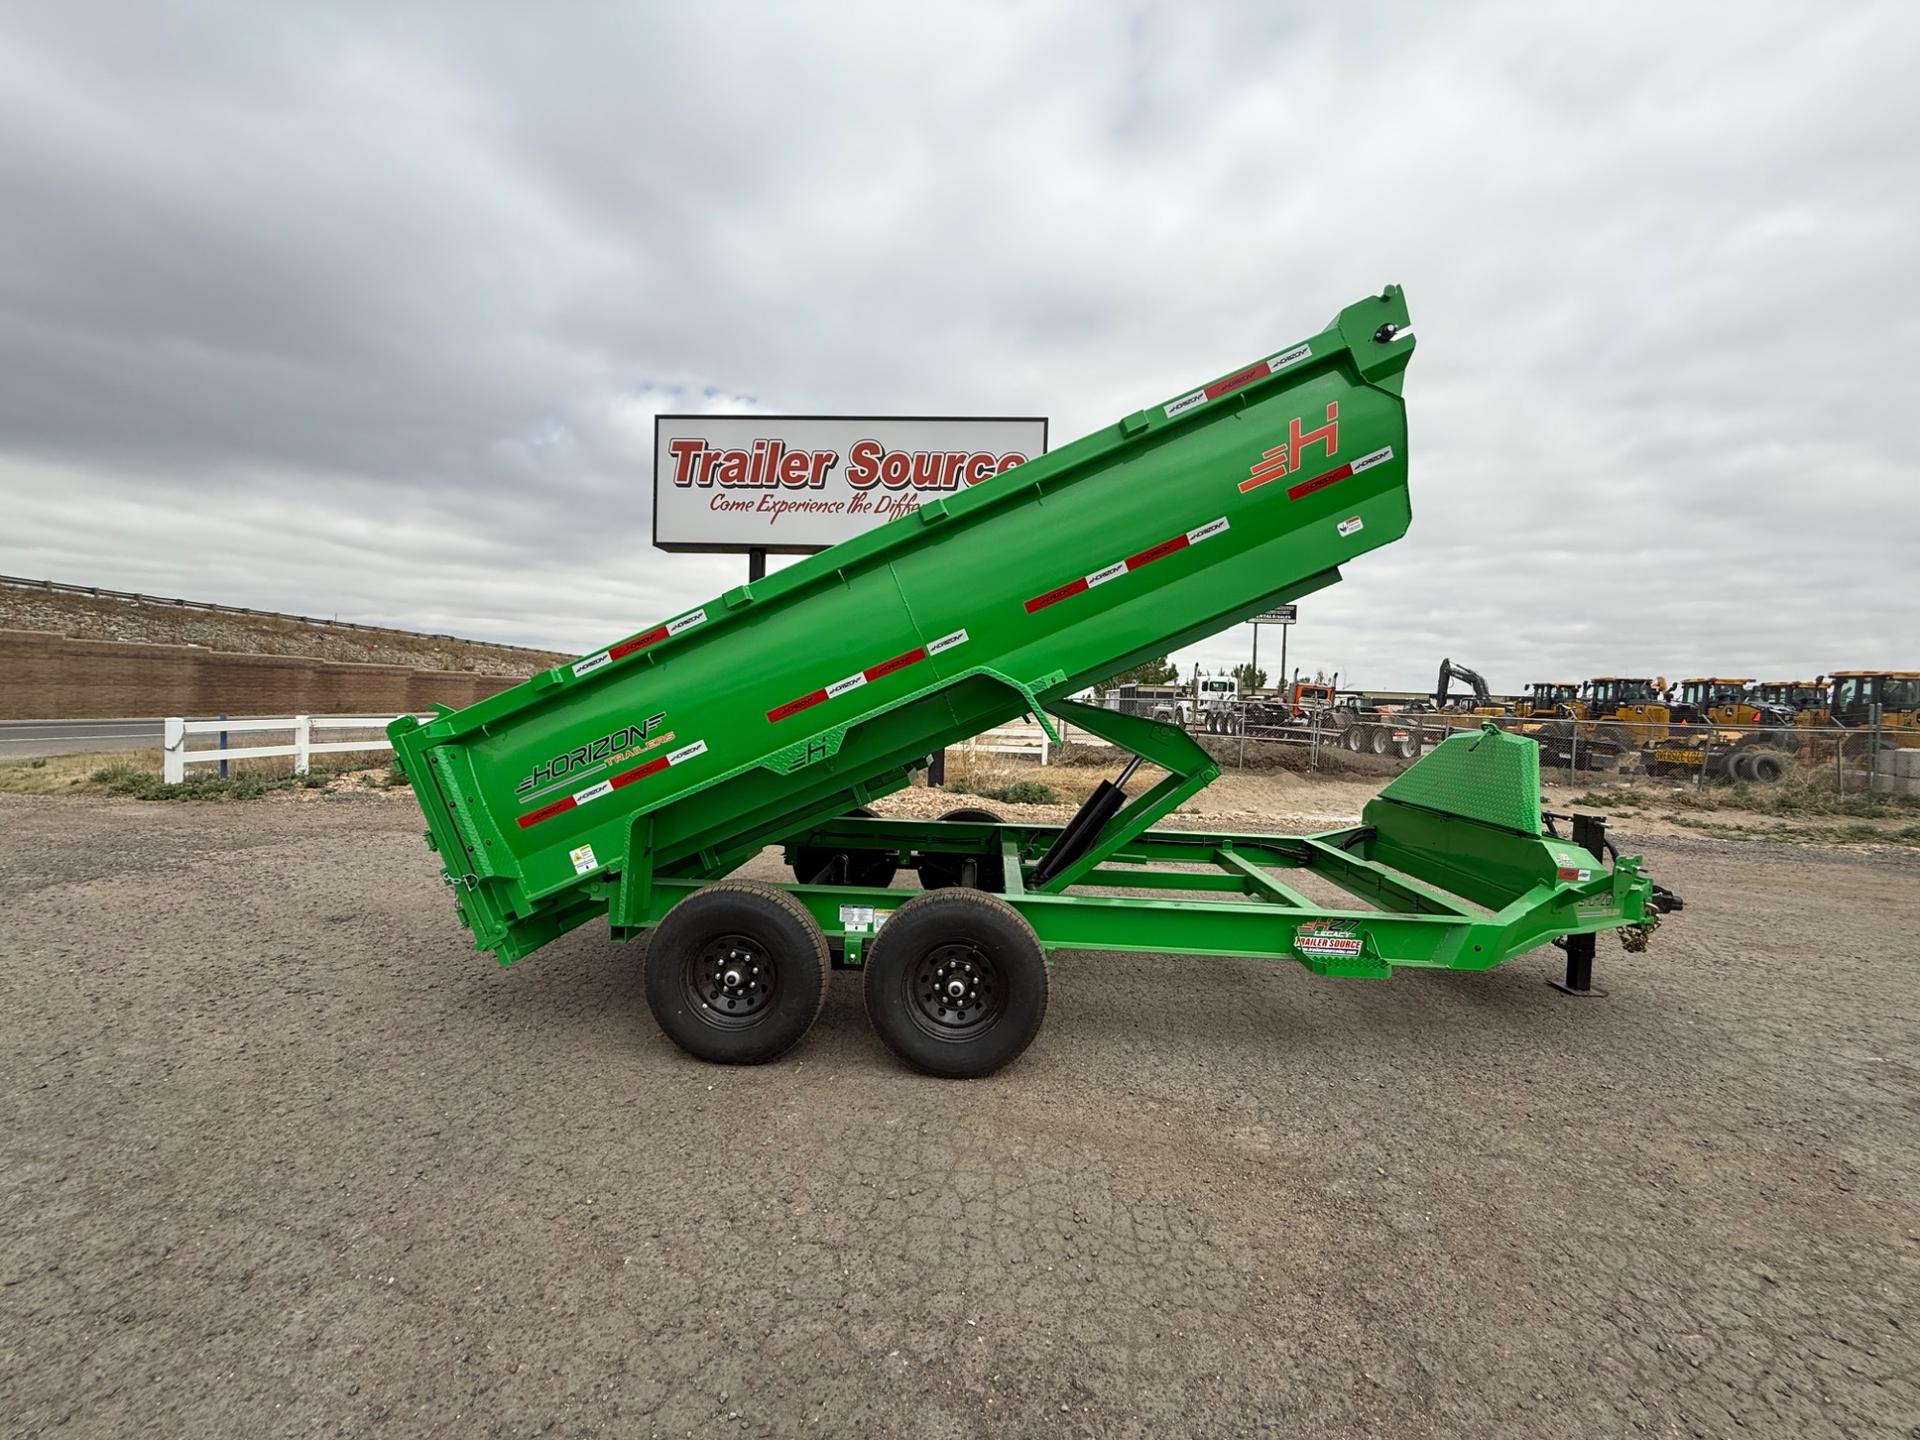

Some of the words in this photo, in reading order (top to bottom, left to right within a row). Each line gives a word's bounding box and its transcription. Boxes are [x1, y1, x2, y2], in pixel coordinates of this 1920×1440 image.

[669, 438, 839, 489] Trailer
[710, 493, 755, 512] Come
[756, 493, 845, 525] Experience
[847, 491, 871, 514] the
[874, 493, 920, 522] Diffe
[530, 716, 652, 788] HORIZON
[603, 731, 676, 768] TRAILERS
[577, 784, 607, 801] HORIZON
[671, 744, 702, 761] HORIZON
[1295, 937, 1328, 947] TRAILER
[1328, 939, 1361, 949] SOURCE
